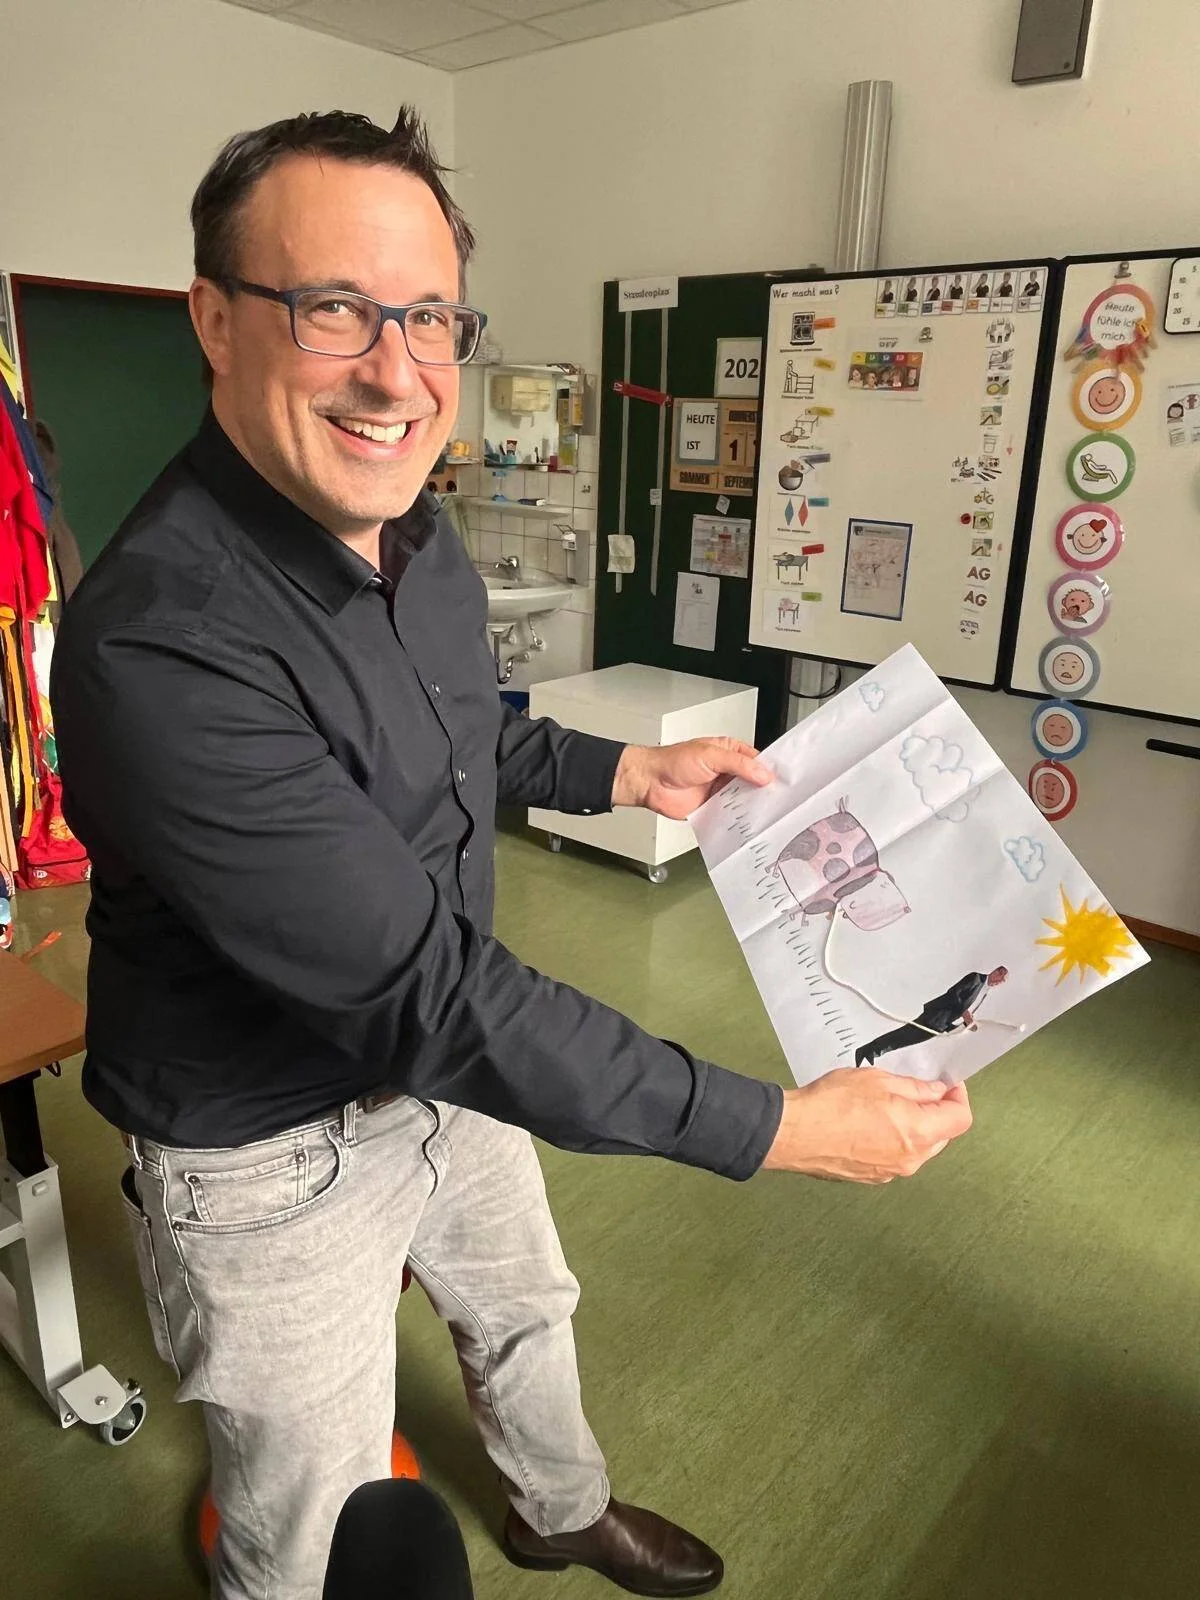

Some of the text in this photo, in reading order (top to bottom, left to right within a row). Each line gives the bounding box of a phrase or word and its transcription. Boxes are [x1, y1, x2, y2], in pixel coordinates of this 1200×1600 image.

[623, 288, 671, 300] Stundenplan
[772, 288, 789, 299] Wer
[791, 287, 816, 298] macht
[1105, 303, 1135, 312] Heute
[1097, 316, 1122, 327] fühle
[1101, 332, 1125, 341] mich
[686, 414, 716, 425] HEUTE
[686, 440, 701, 450] IST
[966, 565, 991, 581] AG
[963, 590, 988, 607] AG
